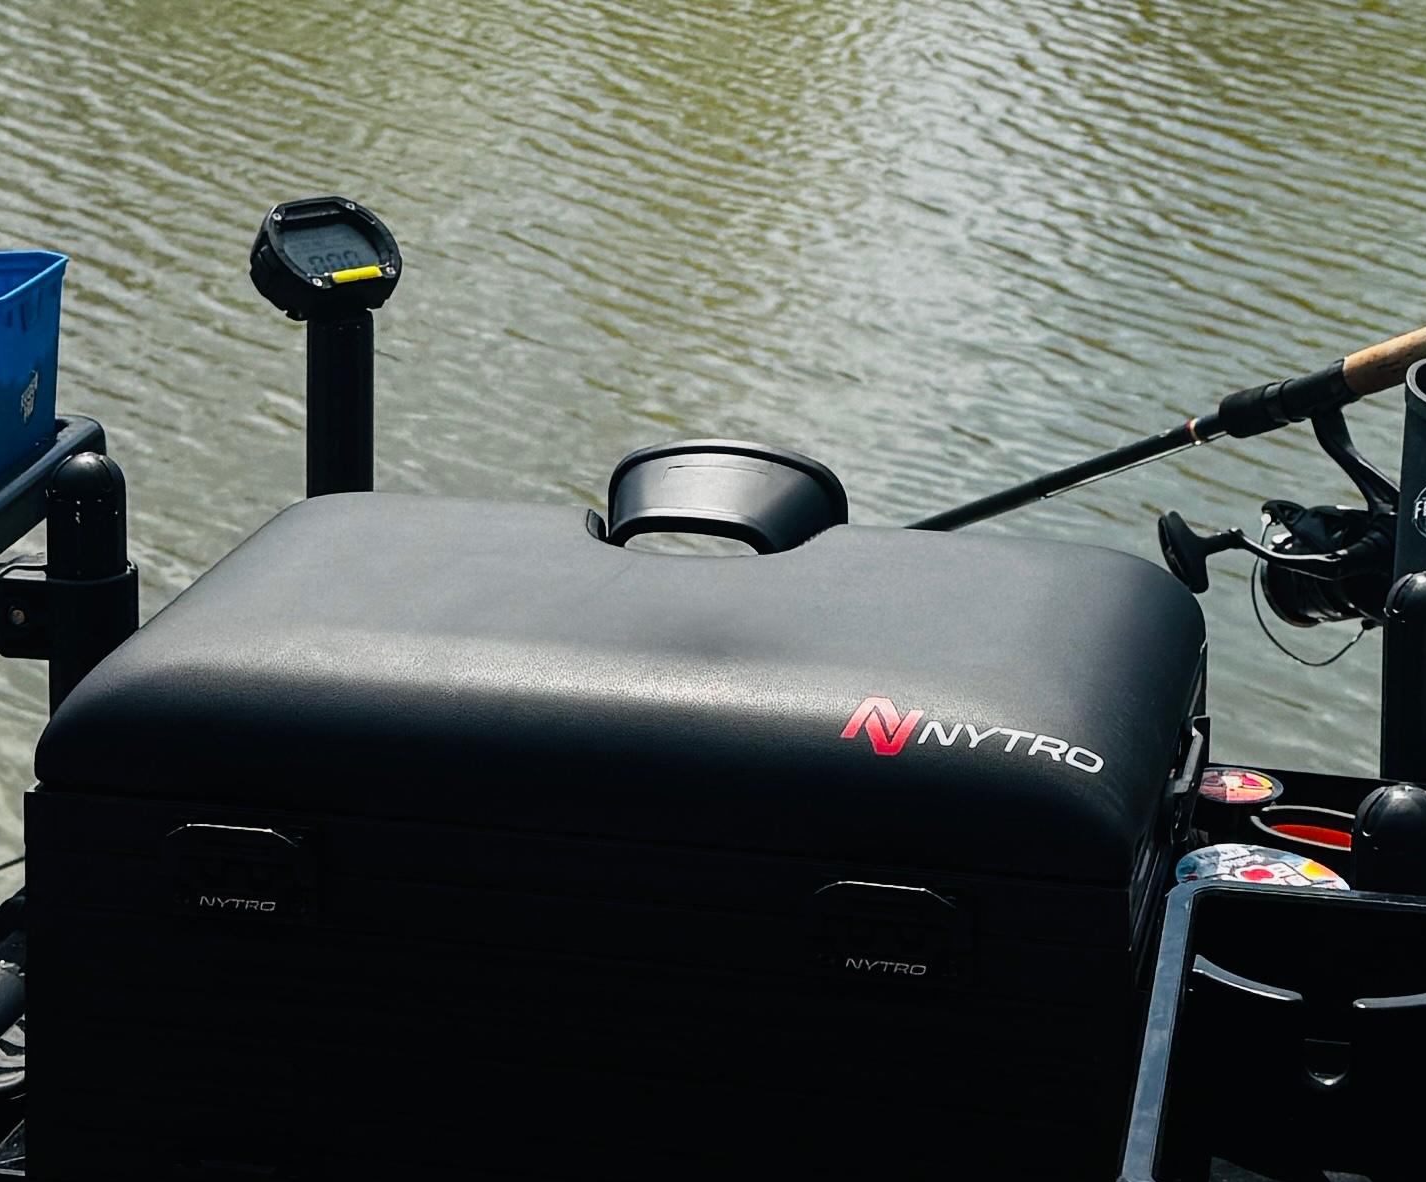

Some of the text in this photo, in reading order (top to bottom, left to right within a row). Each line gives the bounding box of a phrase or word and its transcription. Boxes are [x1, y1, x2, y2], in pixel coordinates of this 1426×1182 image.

[917, 719, 1106, 775] NYTRO
[198, 895, 277, 913] NYTRO
[844, 957, 928, 977] NYTRO
